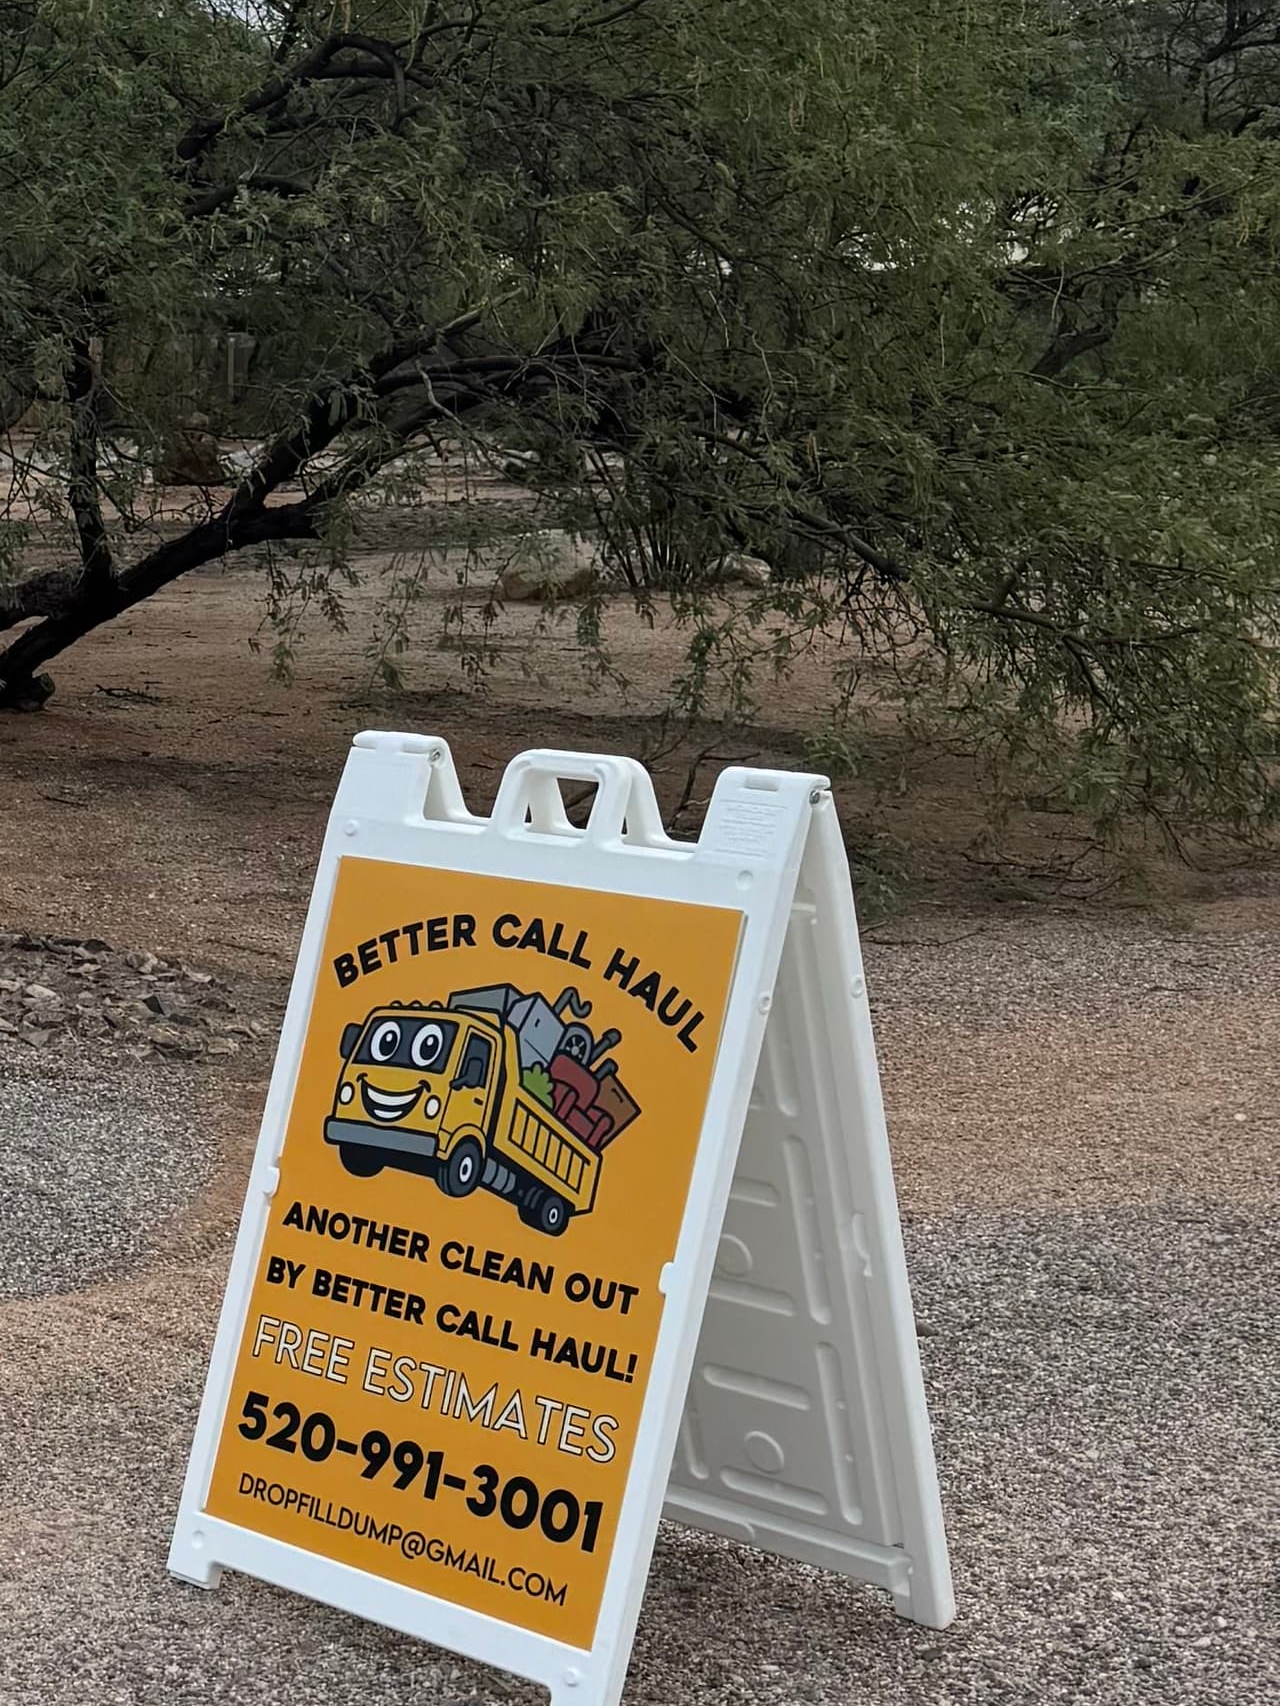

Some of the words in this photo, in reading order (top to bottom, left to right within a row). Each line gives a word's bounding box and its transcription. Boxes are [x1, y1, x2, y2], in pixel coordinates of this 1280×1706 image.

[333, 914, 477, 989] BETTER
[492, 913, 592, 970] CALL
[603, 947, 706, 1054] HAUL
[266, 1256, 306, 1289] BY
[311, 1268, 426, 1325] BETTER
[436, 1304, 519, 1352] CALL
[529, 1328, 639, 1383] HAUL!
[281, 1201, 430, 1263] ANOTHER
[439, 1241, 555, 1295] CLEAN
[564, 1272, 640, 1315] OUT
[251, 1314, 355, 1385] FREE
[361, 1346, 621, 1465] ESTIMATES
[237, 1391, 605, 1554] 520-991-3001
[238, 1472, 569, 1608] DROPFILLDUMP@GMAIL.COM
